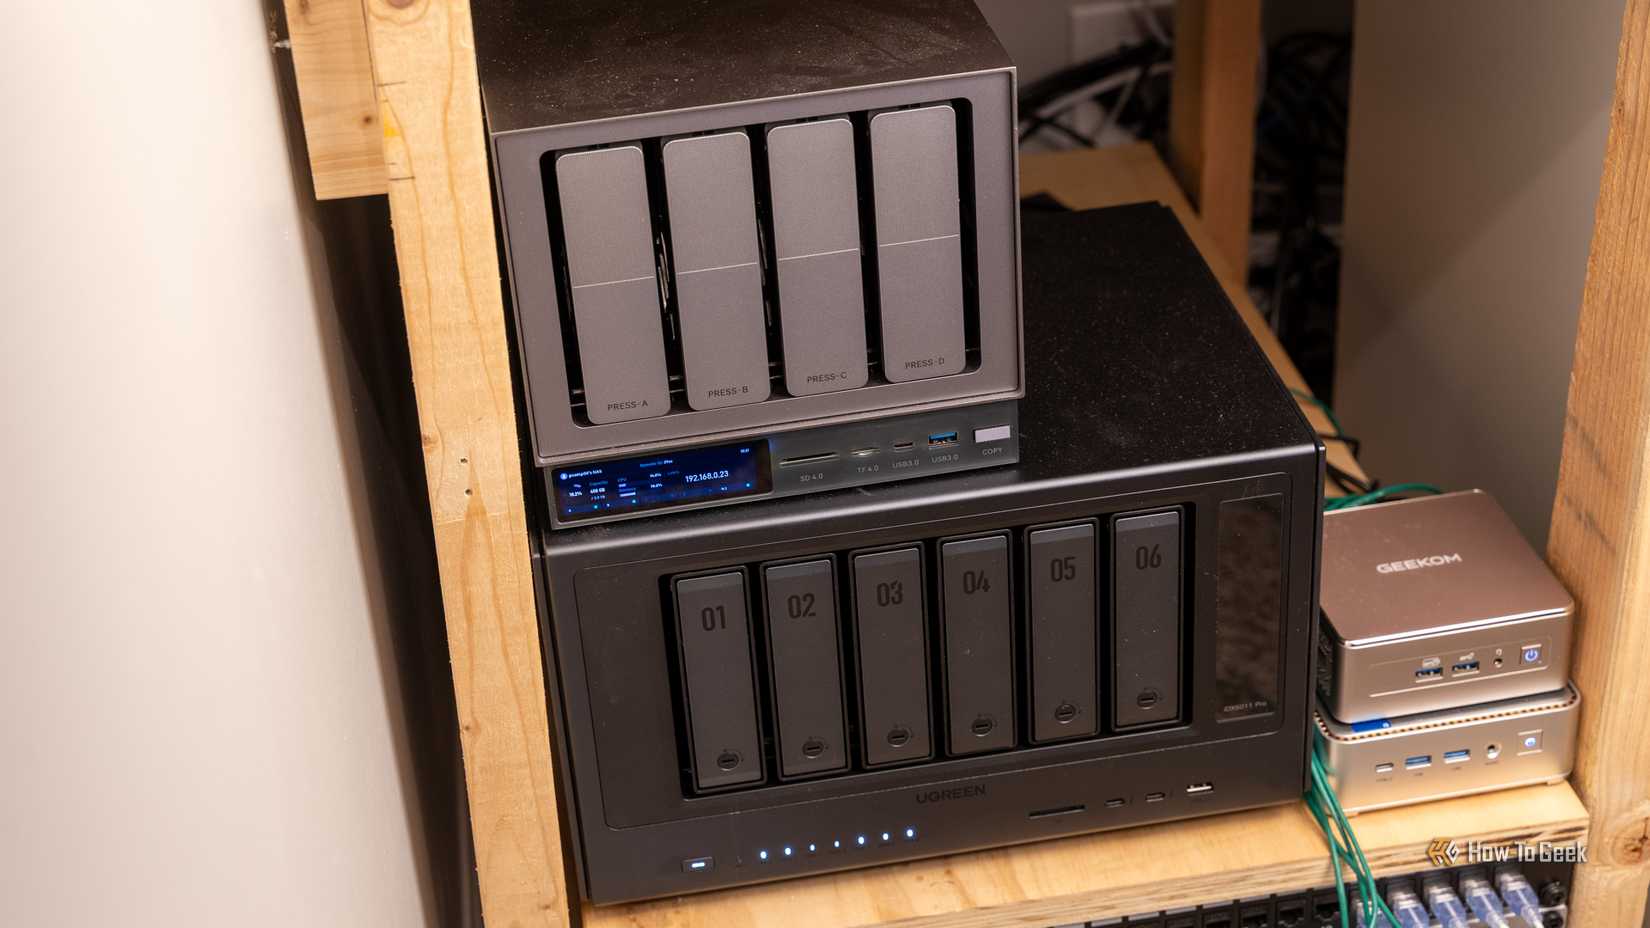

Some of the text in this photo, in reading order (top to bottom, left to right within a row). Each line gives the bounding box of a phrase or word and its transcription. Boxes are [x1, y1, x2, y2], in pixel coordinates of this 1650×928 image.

[905, 357, 945, 370] PRESS-D
[807, 371, 847, 384] PRESS-C
[708, 385, 749, 399] PRESS-B
[607, 399, 649, 412] PRESS-A
[982, 447, 1003, 456] COPY
[685, 470, 729, 483] 192.168.0.23
[1136, 544, 1162, 571] 06
[1376, 553, 1463, 574] GEEKOM
[1050, 556, 1077, 583] 05
[963, 569, 991, 596] 04
[877, 581, 904, 608] 03
[788, 593, 816, 620] 02
[702, 605, 727, 632] 01
[916, 784, 987, 804] UGREEN
